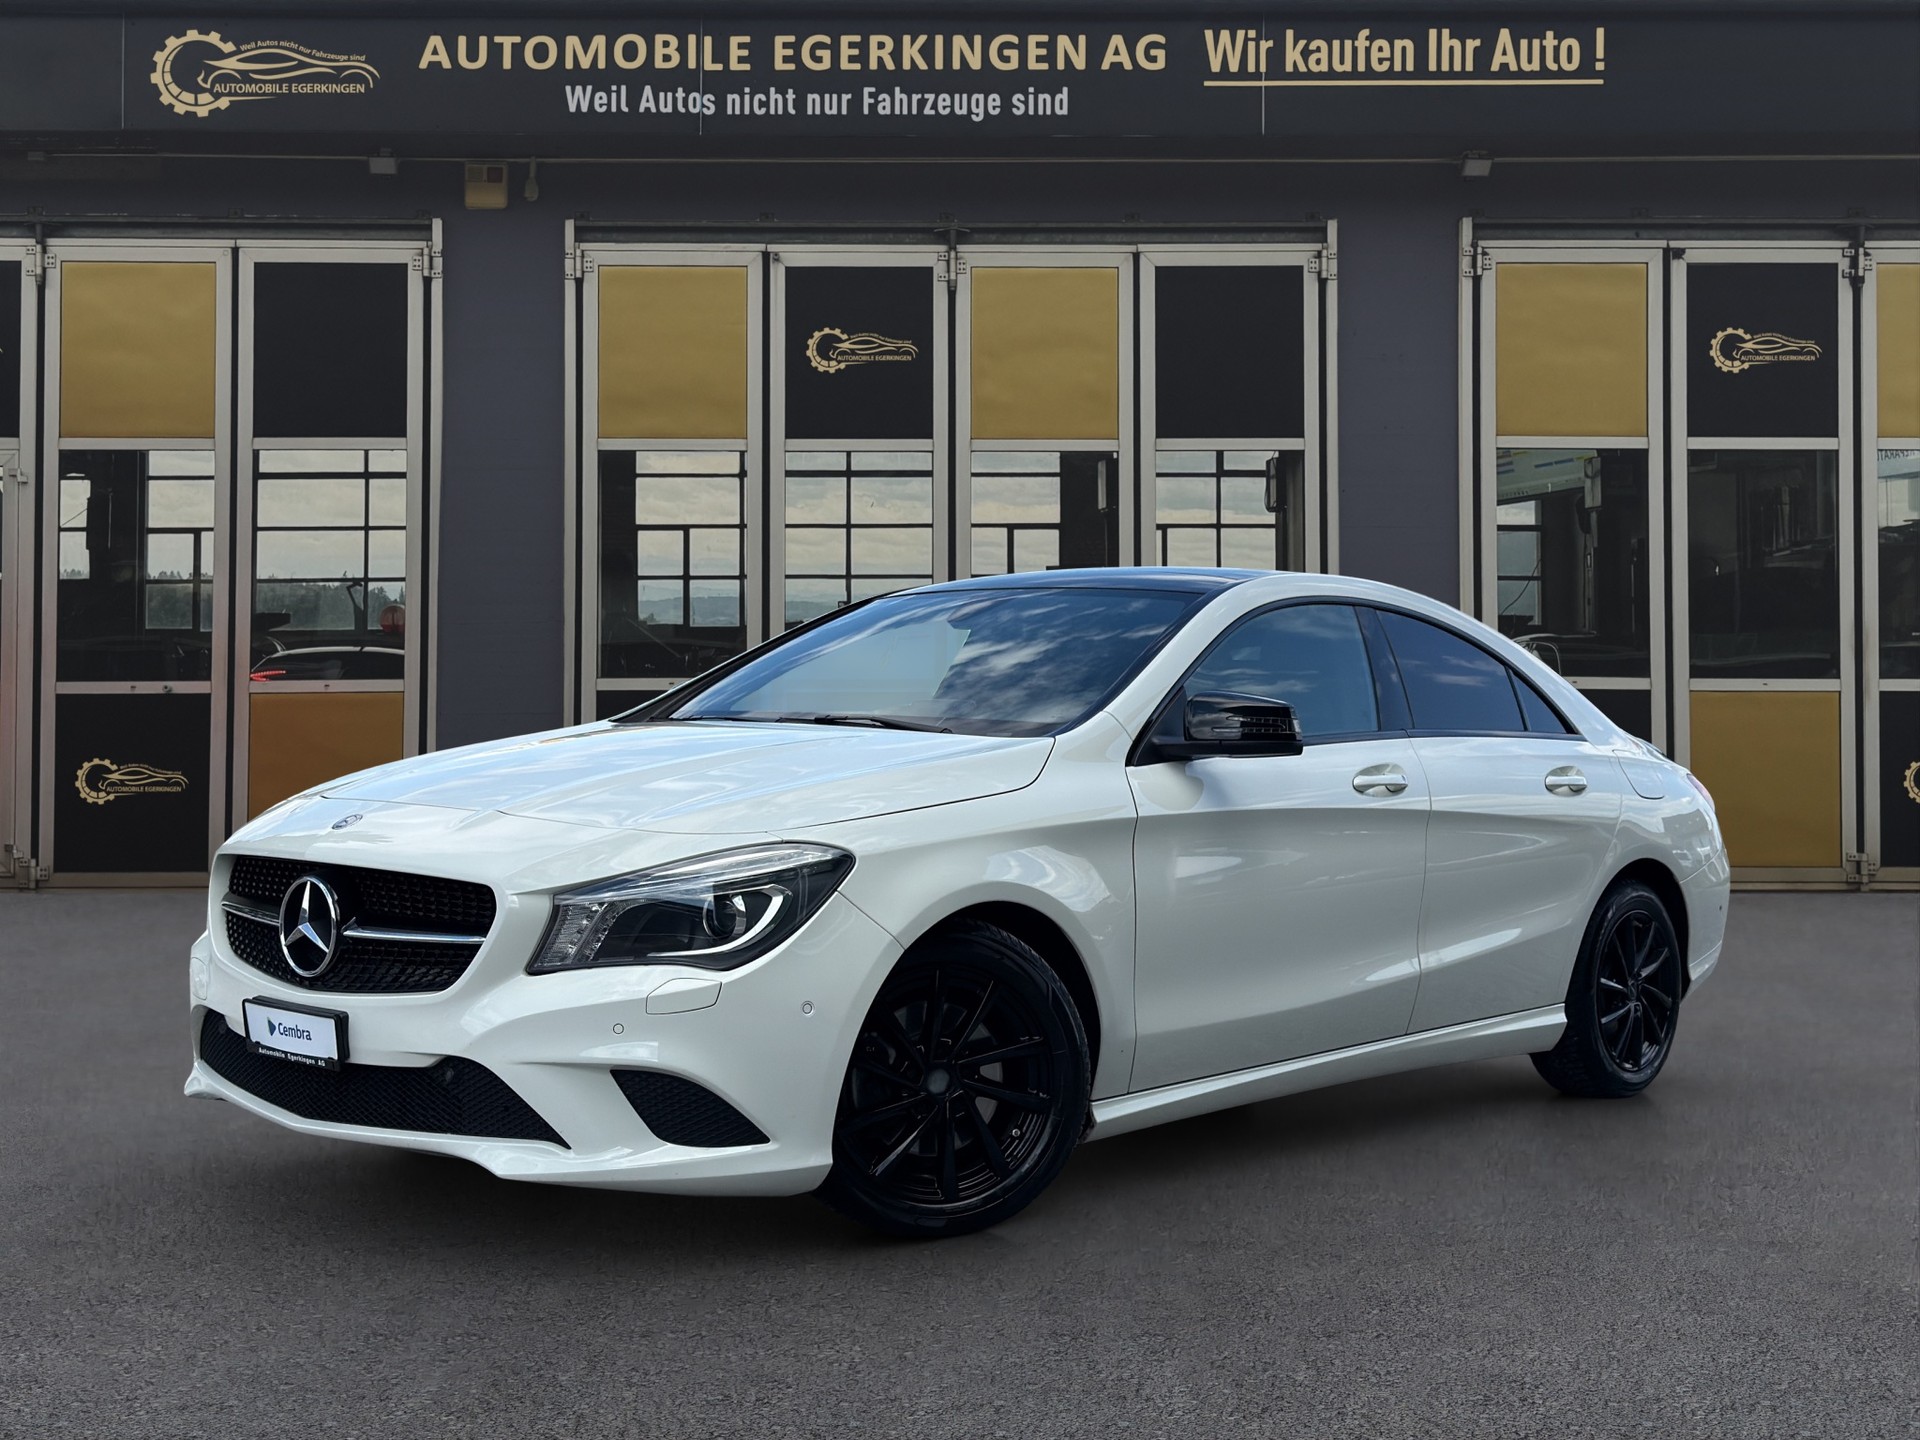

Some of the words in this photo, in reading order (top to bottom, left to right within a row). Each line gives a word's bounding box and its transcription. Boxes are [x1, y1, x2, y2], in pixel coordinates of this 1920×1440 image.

[240, 43, 256, 51] Weil
[279, 40, 299, 50] nicht
[298, 45, 312, 55] nur
[312, 49, 348, 61] Fahrzeuge
[418, 33, 751, 71] AUTOMOBILE
[773, 33, 1087, 71] EGERKINGEN
[1100, 33, 1167, 71] AG
[1204, 28, 1273, 73] Wir
[1285, 28, 1415, 73] kaufen
[1428, 28, 1481, 73] Ihr
[1490, 27, 1581, 72] Auto
[213, 83, 289, 94] AUTOMOBILE
[291, 83, 366, 94] EGERKINGEN
[565, 85, 628, 113] Weil
[638, 85, 716, 115] Autos
[726, 87, 796, 116] nicht
[806, 92, 852, 116] nur
[862, 86, 1001, 122] Fahrzeuge
[1011, 86, 1069, 116] sind
[278, 1023, 312, 1040] Cembra
[259, 1047, 285, 1058] Automobile
[288, 1054, 315, 1064] Egerkingen
